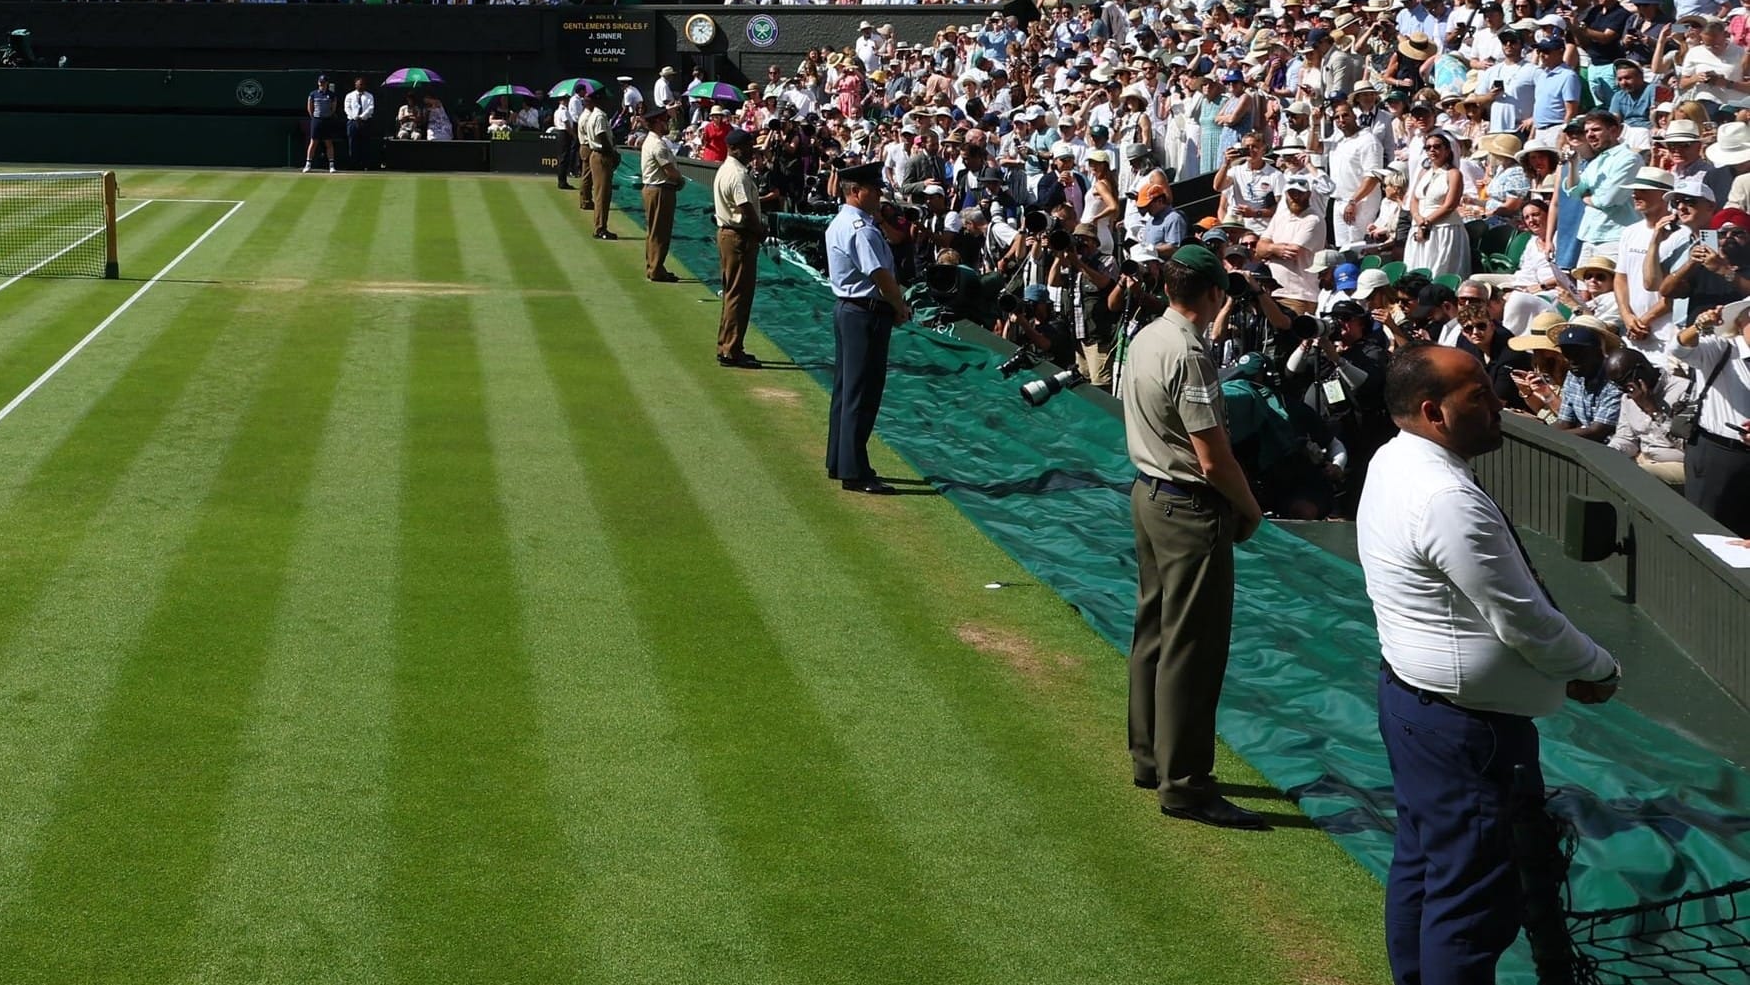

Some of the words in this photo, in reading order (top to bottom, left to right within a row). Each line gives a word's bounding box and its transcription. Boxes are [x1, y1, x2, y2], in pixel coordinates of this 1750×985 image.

[562, 22, 610, 30] GENTLEMEN'S
[612, 22, 643, 30] SINGLES
[588, 32, 595, 40] J.
[596, 32, 622, 40] SINNER
[491, 130, 511, 141] IBM
[541, 157, 559, 168] mp
